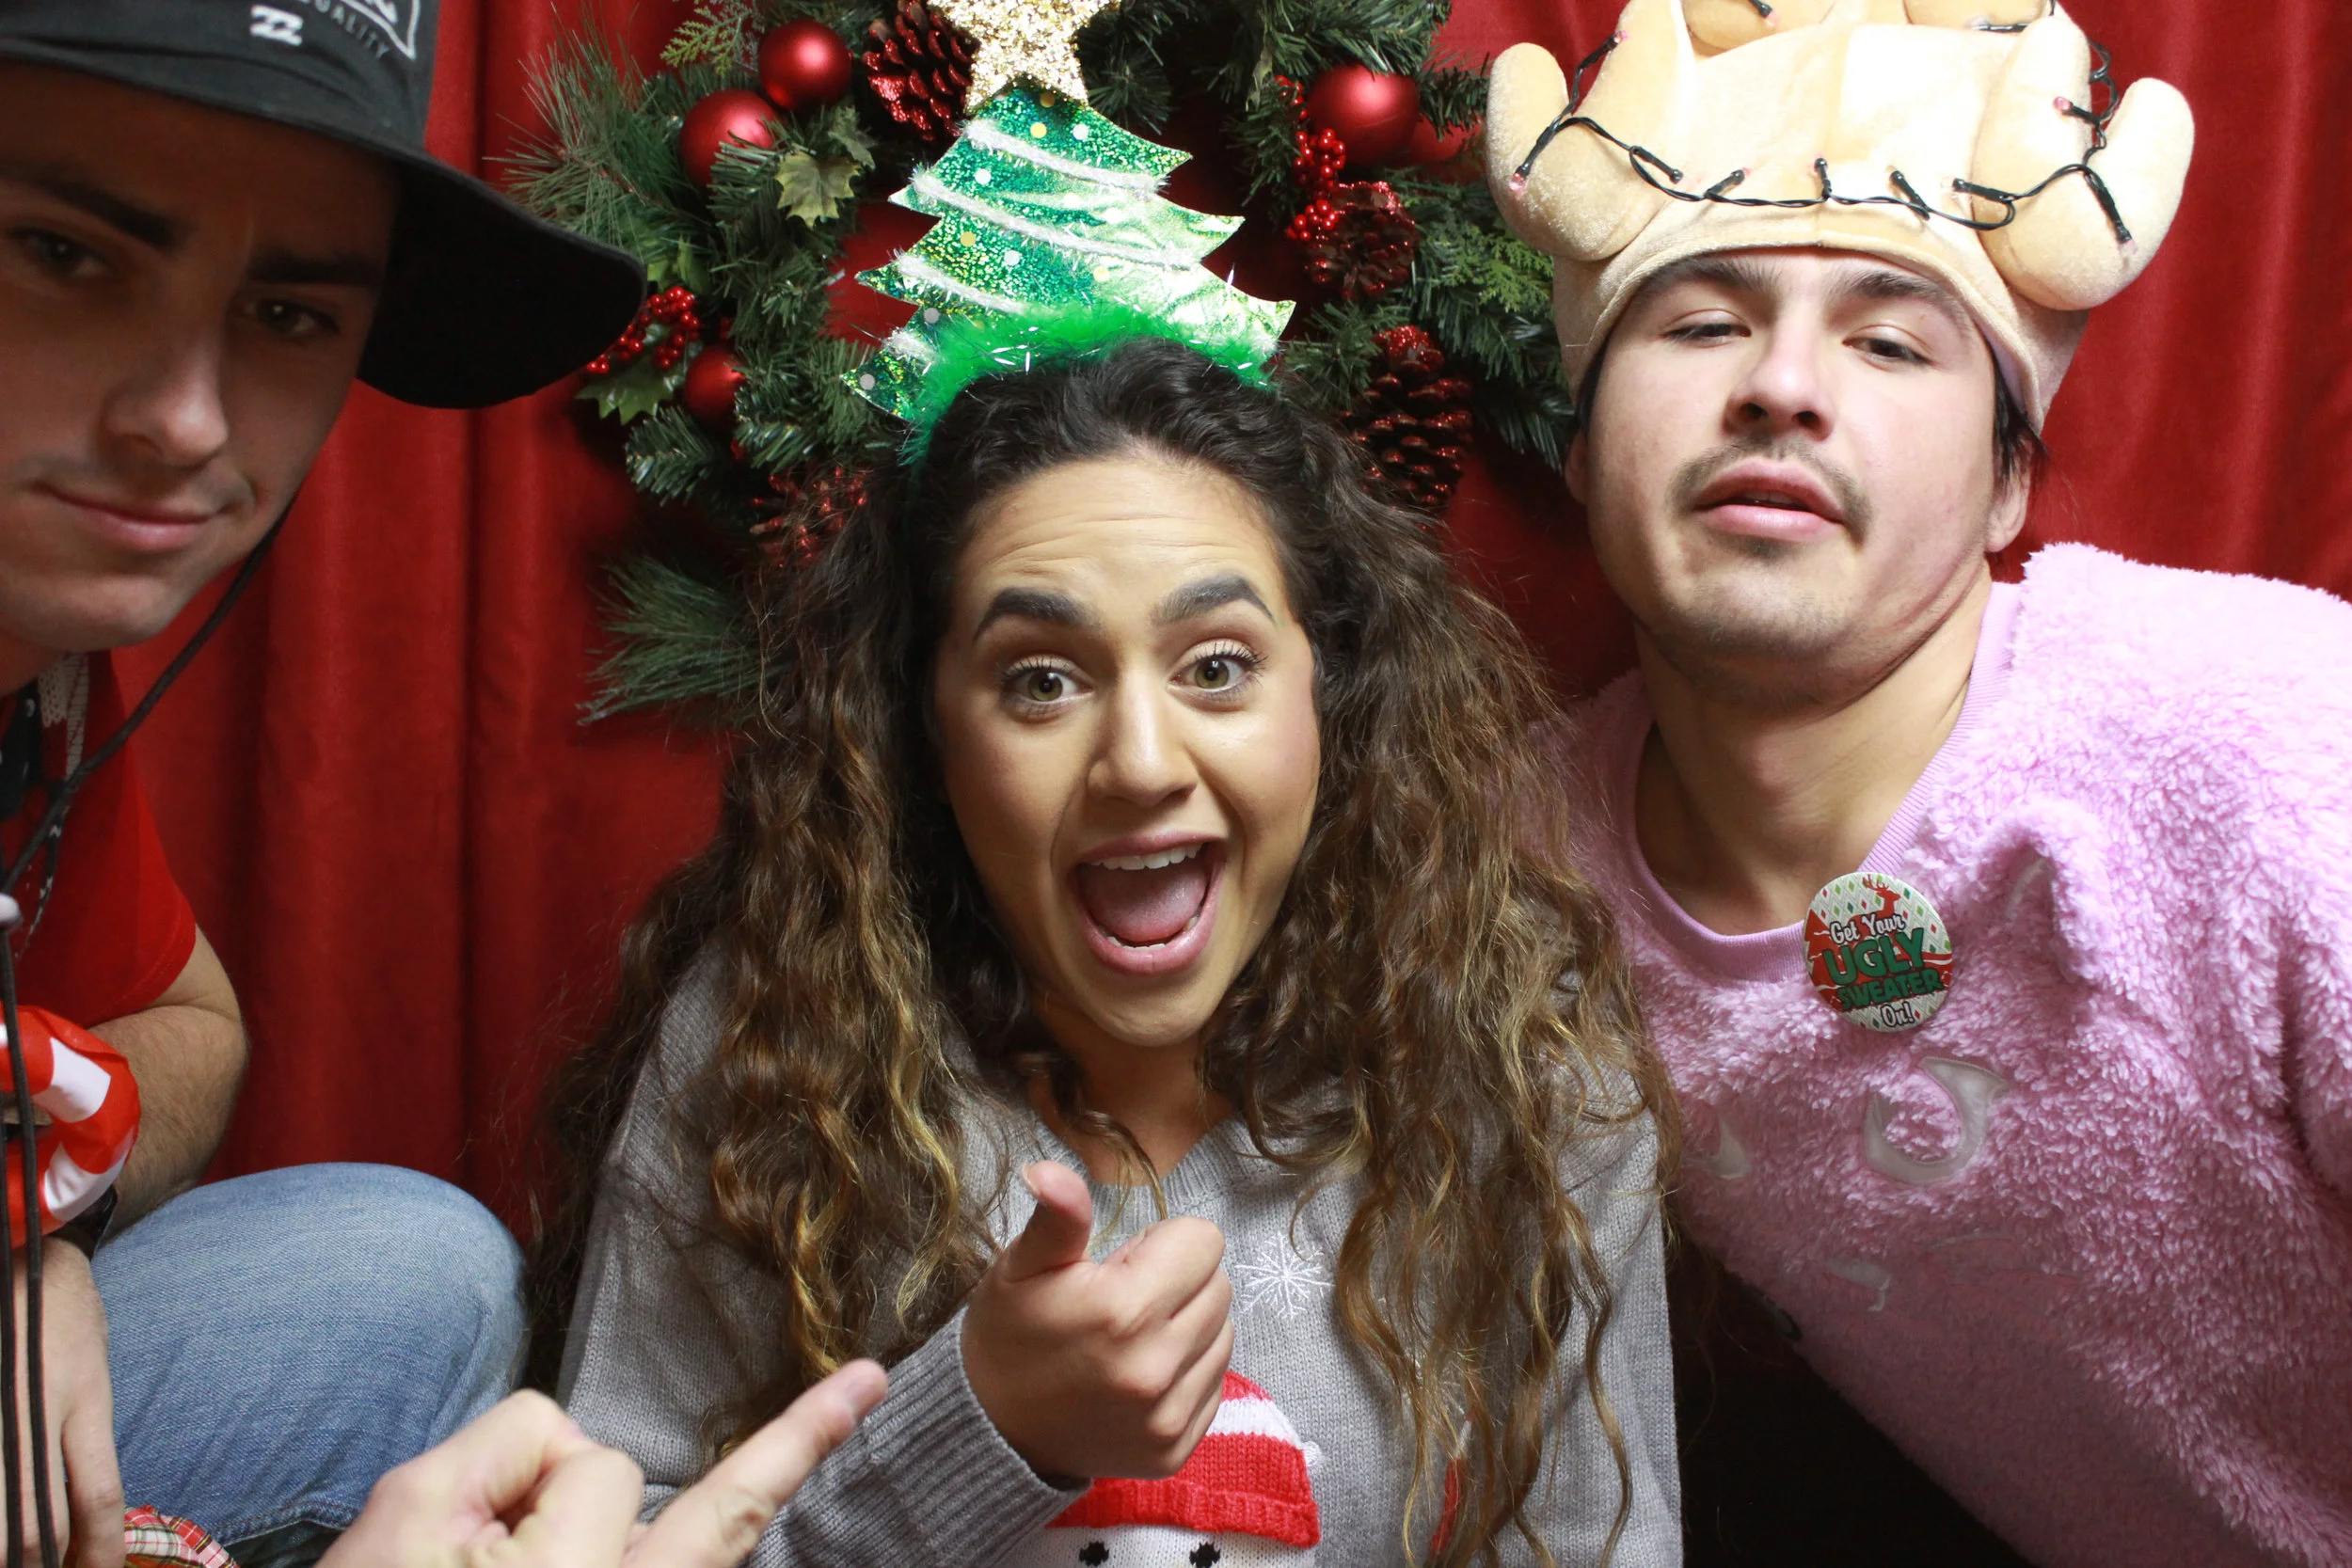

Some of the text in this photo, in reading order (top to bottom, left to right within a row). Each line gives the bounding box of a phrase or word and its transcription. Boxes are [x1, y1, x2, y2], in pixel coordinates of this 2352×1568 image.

[301, 0, 390, 58] UALITY
[1830, 912, 1906, 944] Get Your
[1822, 927, 1925, 986] UGLY
[1836, 969, 1945, 1010] SWEATER
[1881, 1001, 1915, 1028] On!
